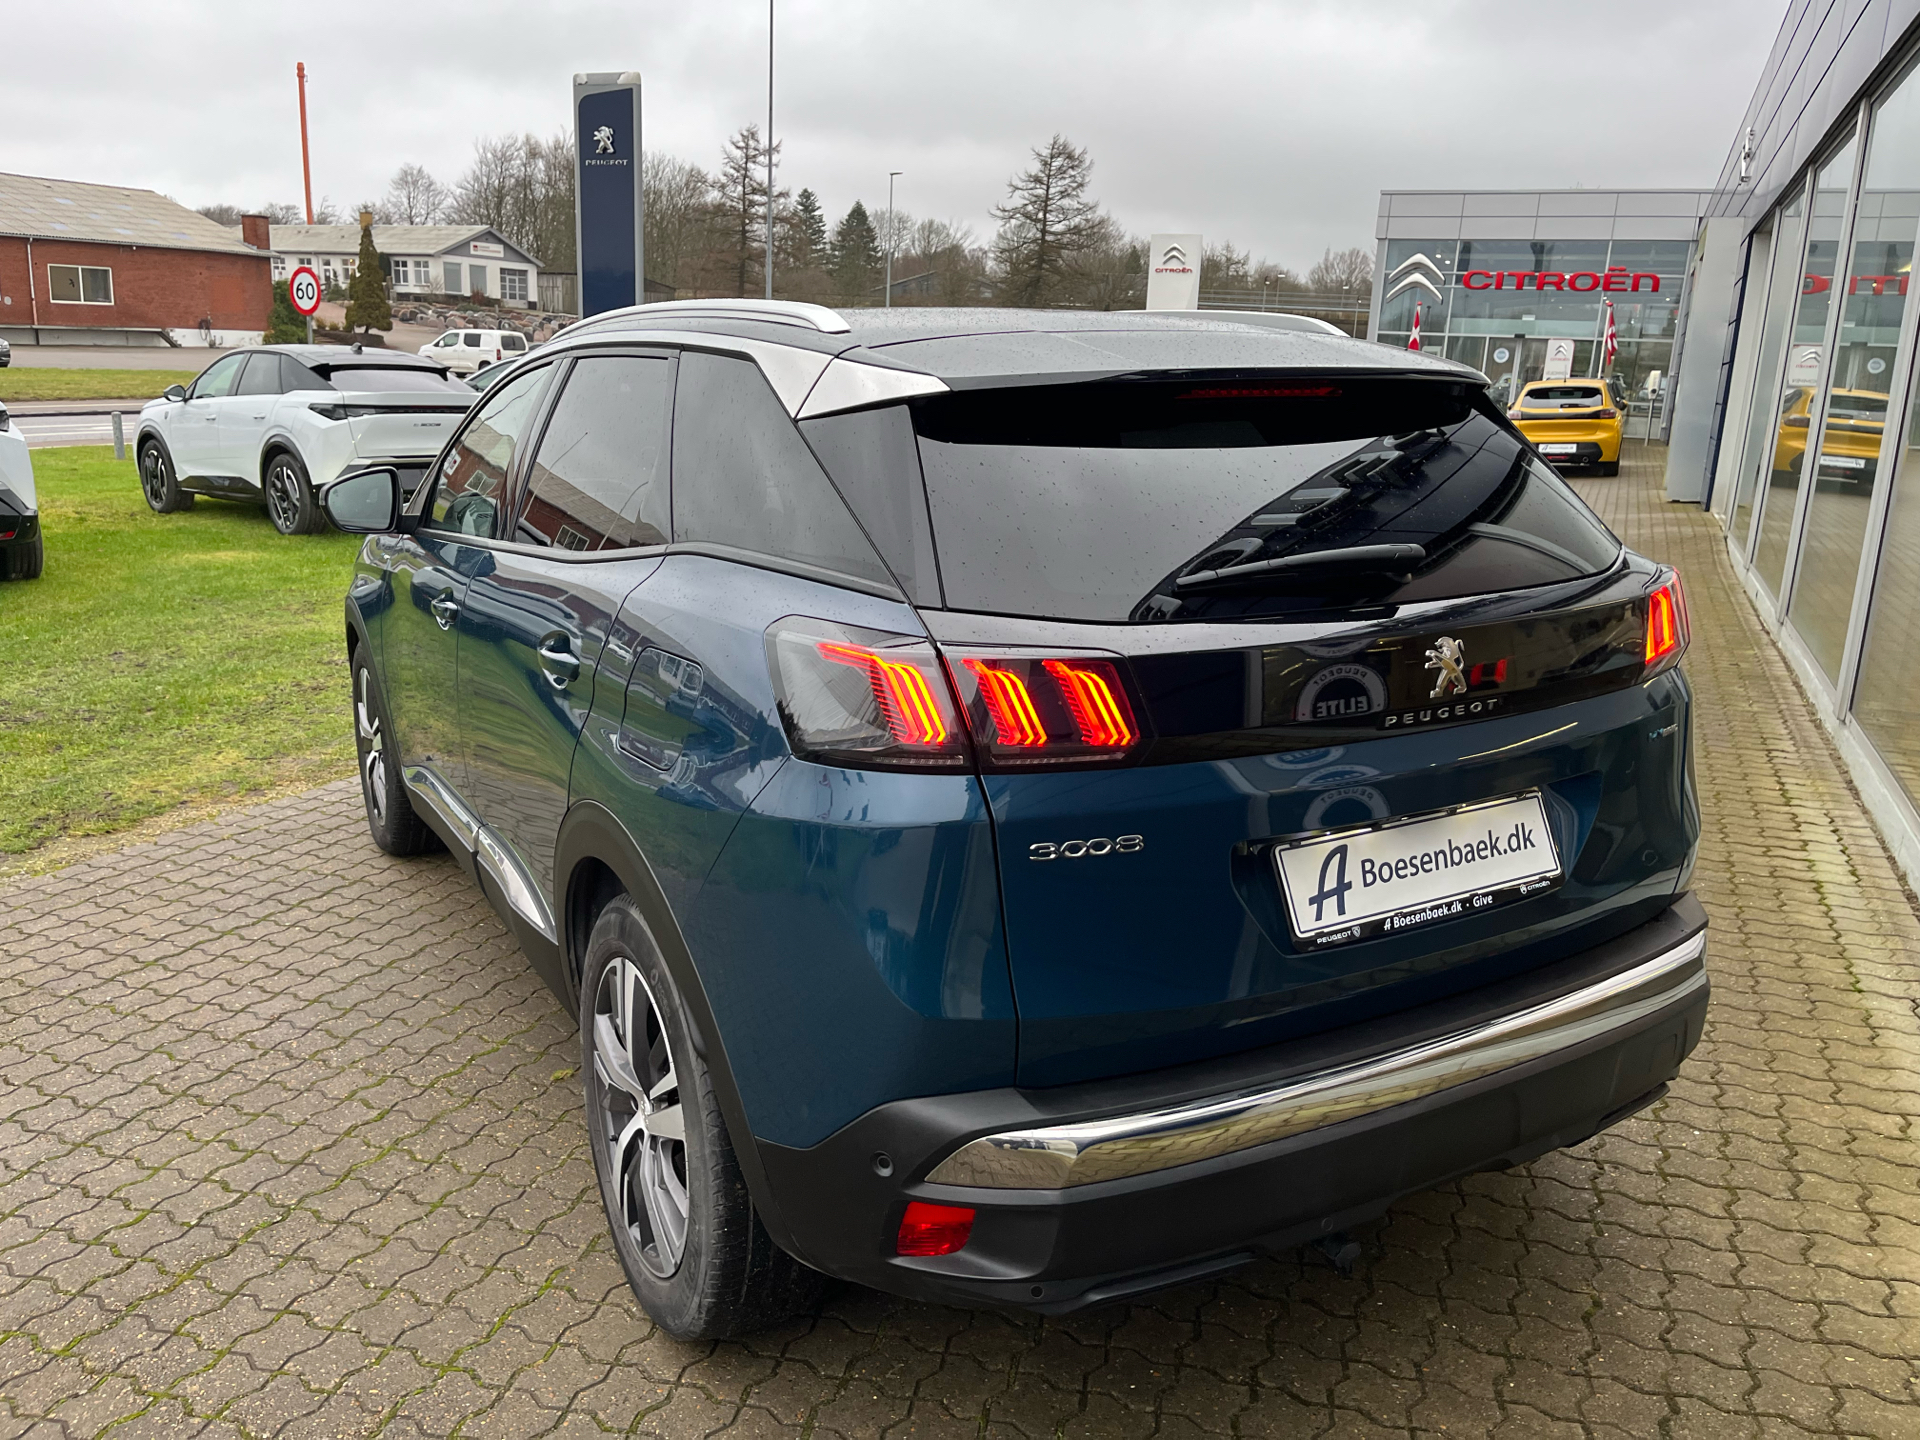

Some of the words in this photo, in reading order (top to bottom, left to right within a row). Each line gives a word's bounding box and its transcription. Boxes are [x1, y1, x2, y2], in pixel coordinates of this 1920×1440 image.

[585, 158, 629, 167] PEUGEOT
[1154, 266, 1193, 274] CITROËN
[1462, 266, 1661, 293] CITROËN
[296, 282, 315, 300] 60
[1384, 698, 1498, 728] PEUGEOT
[1029, 834, 1145, 861] 3008
[1308, 843, 1353, 922] A
[1360, 821, 1537, 888] Boesenbaek.dk
[1527, 880, 1551, 892] CITROËN
[1384, 918, 1391, 931] A
[1393, 900, 1463, 929] Boesenbaek.dk
[1473, 893, 1493, 908] Give
[1316, 929, 1352, 945] PEUGEOT
